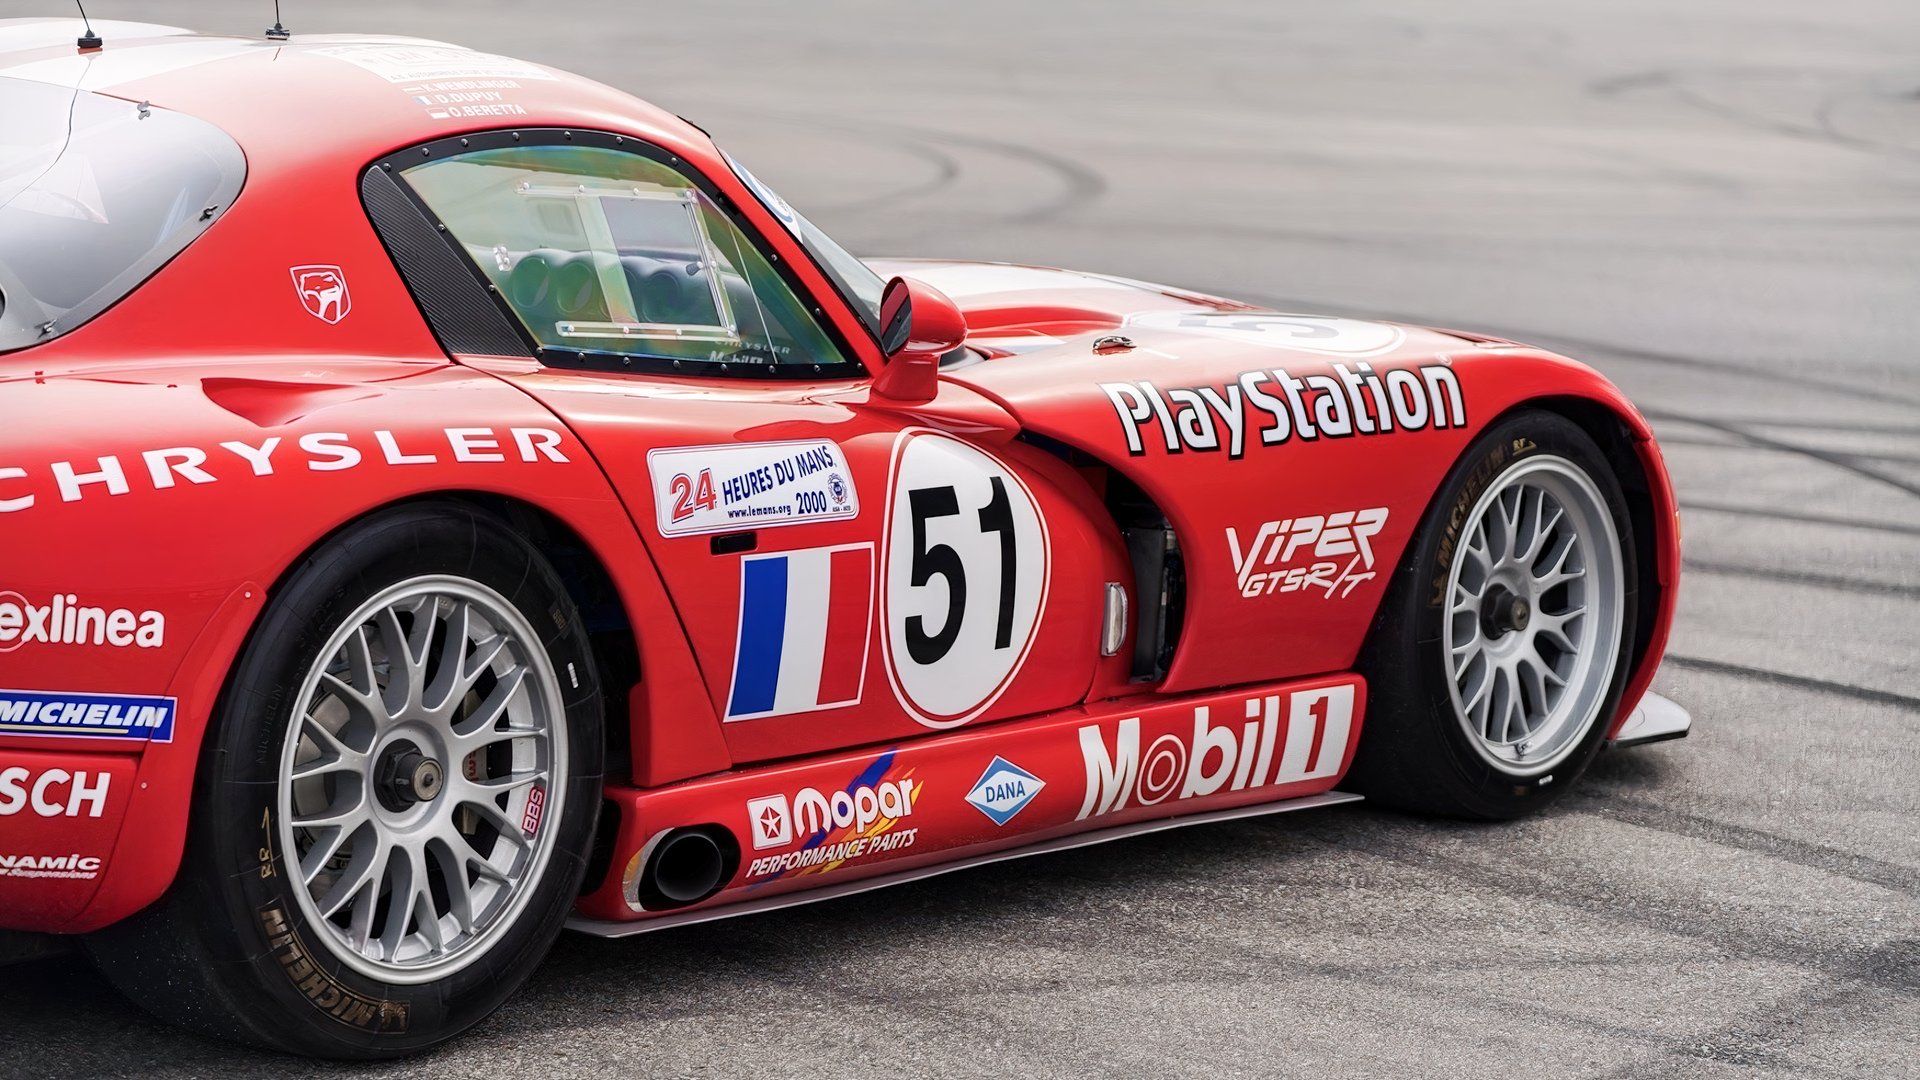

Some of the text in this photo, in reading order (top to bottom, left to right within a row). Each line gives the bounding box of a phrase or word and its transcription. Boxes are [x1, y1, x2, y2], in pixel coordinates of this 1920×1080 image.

[435, 91, 503, 104] D.DUPUY
[450, 104, 528, 118] O.BERETTA
[1099, 361, 1468, 460] PlayStation
[669, 445, 834, 524] 24 HEURES DU MANS
[728, 490, 827, 519] www.lemans.org 2000
[905, 476, 1017, 666] 51
[1225, 506, 1389, 591] VIPER
[0, 593, 166, 649] exlinea
[0, 699, 168, 728] MICHELIN
[1075, 695, 1280, 822] Mobil
[0, 766, 112, 818] SCH
[522, 786, 544, 835] BBS
[985, 780, 1027, 804] DANA
[746, 827, 919, 879] PERFORMANCE PARTS
[260, 908, 377, 1028] MICHELIN
